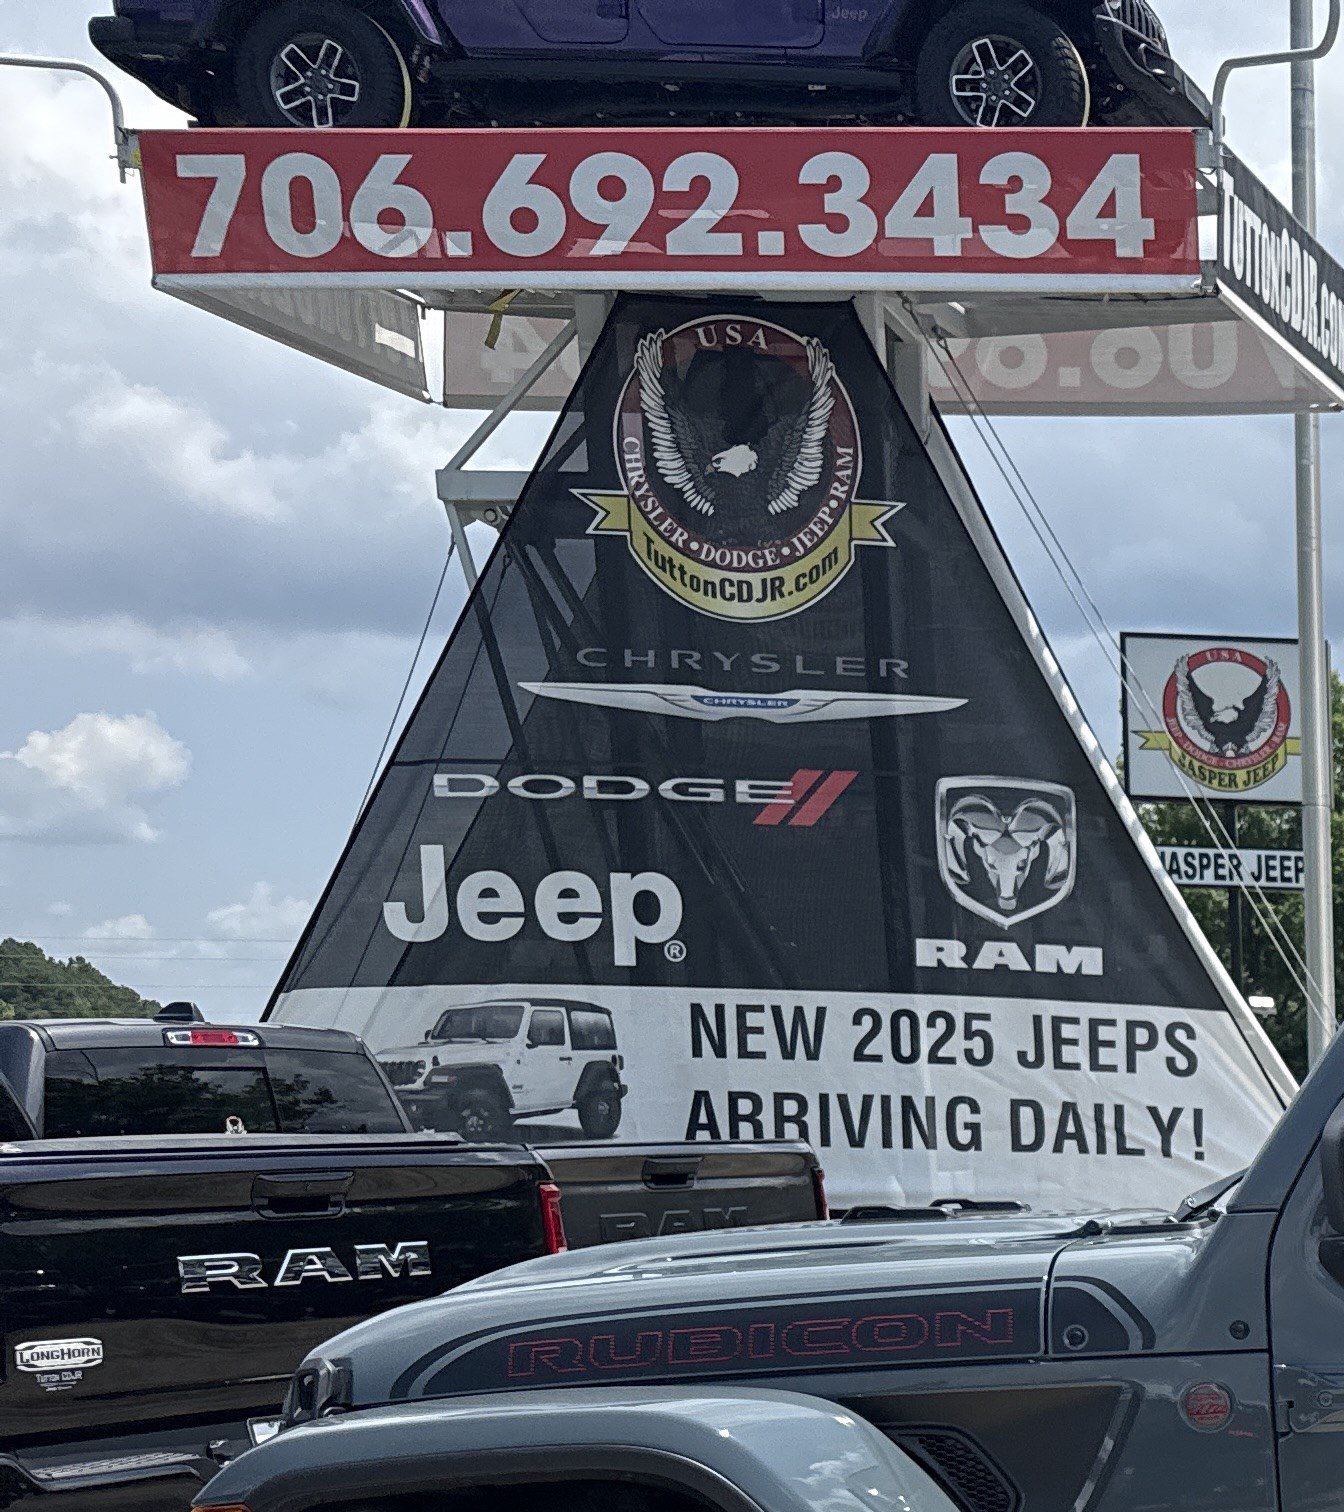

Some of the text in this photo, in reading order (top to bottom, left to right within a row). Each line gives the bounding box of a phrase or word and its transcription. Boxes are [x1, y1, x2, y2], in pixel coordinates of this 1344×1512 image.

[831, 5, 868, 21] Jeep
[176, 151, 1155, 258] 706.692.3434
[696, 323, 768, 351] USA
[622, 436, 855, 569] CHRYSLER DODGE JEEP RAM
[642, 531, 840, 603] TuttonCDJR.com
[576, 648, 909, 679] CHRYSLER
[1205, 650, 1243, 663] USA
[701, 696, 789, 708] CHRYSLER
[433, 773, 795, 804] DODGE
[1178, 753, 1279, 790] JASPER JEEP
[1250, 854, 1304, 884] JEEP
[383, 844, 684, 967] Jeep
[916, 937, 1104, 976] RAM
[690, 1002, 1200, 1078] NEW 2025 JEEPS
[683, 1089, 1206, 1161] ARRIVING DAILY!
[600, 1206, 750, 1243] RAM
[176, 1240, 432, 1294] RAM
[19, 1346, 102, 1364] LONGHORN
[507, 1308, 1014, 1379] RUBICON
